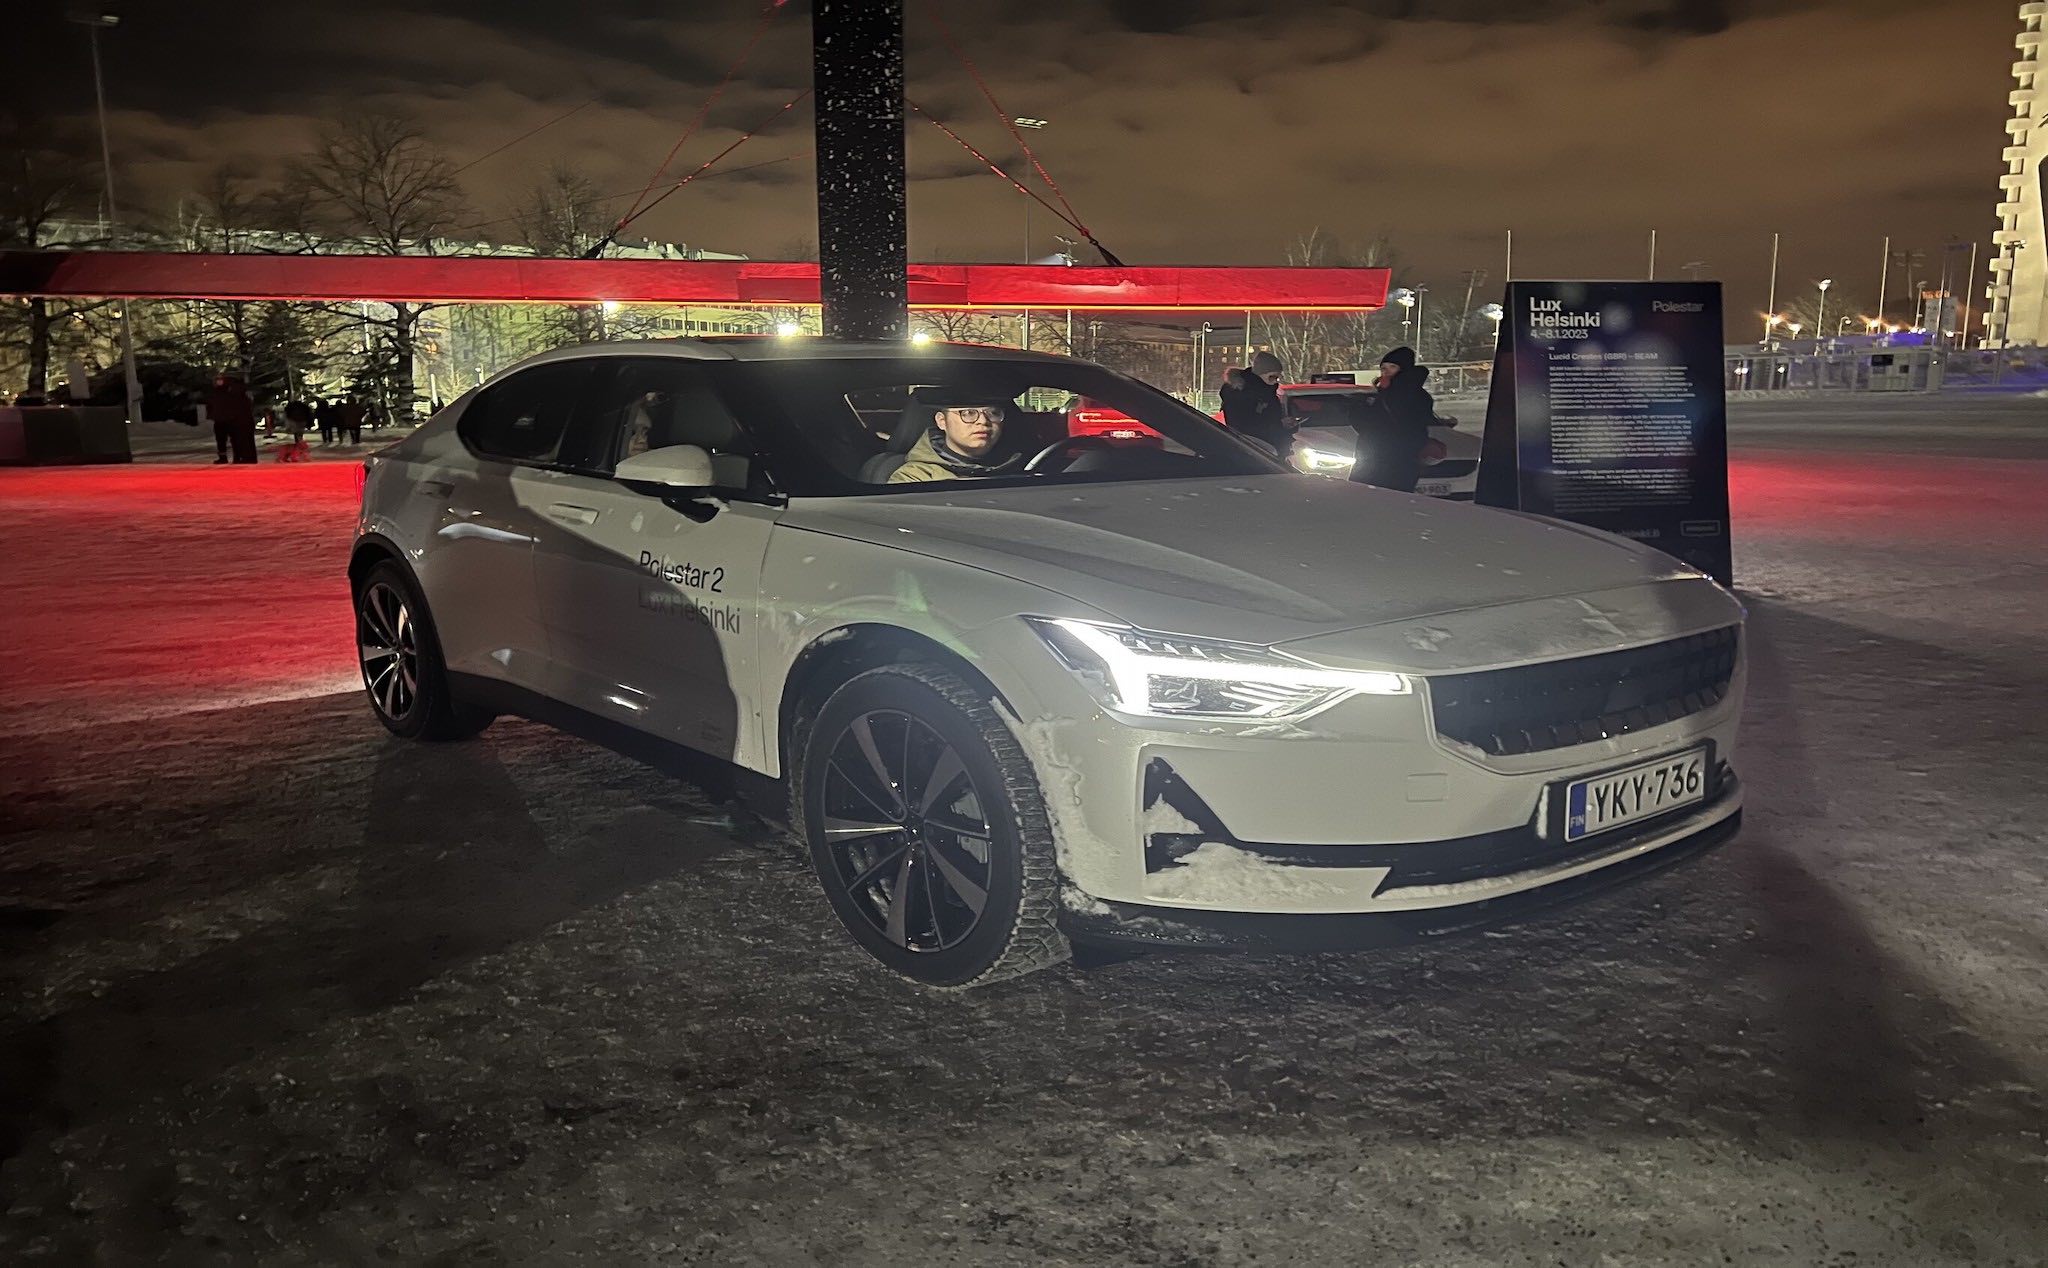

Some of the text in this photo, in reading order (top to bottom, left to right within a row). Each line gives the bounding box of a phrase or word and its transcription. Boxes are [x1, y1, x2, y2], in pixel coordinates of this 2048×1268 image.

[1530, 296, 1562, 312] Lux
[1652, 301, 1704, 312] Polestar
[1530, 312, 1600, 327] Helsinki
[639, 550, 725, 593] Polestar 2
[671, 590, 741, 635] Helsinki
[1570, 814, 1585, 828] FIN
